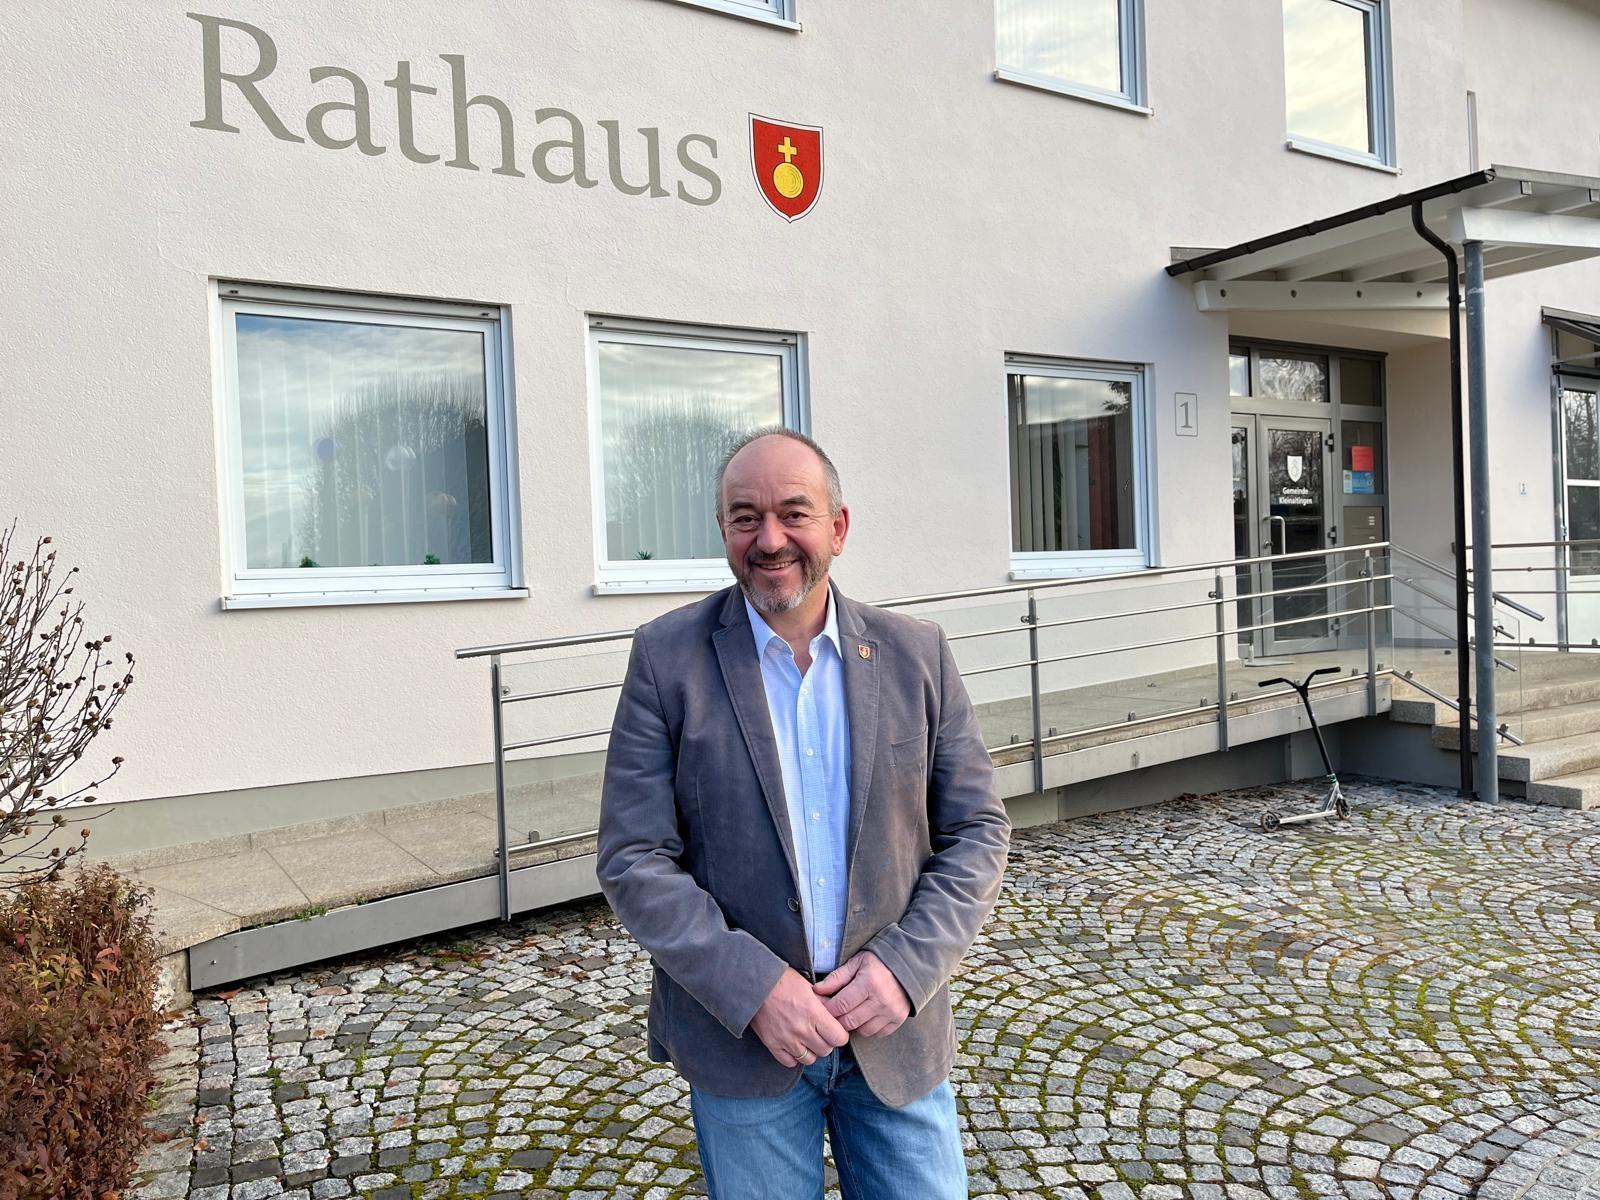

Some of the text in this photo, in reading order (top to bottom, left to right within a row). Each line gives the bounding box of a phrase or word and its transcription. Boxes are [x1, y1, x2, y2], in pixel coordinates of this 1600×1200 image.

[186, 12, 722, 206] Rathaus
[1180, 401, 1192, 428] 1
[1282, 486, 1309, 495] Gemeinde
